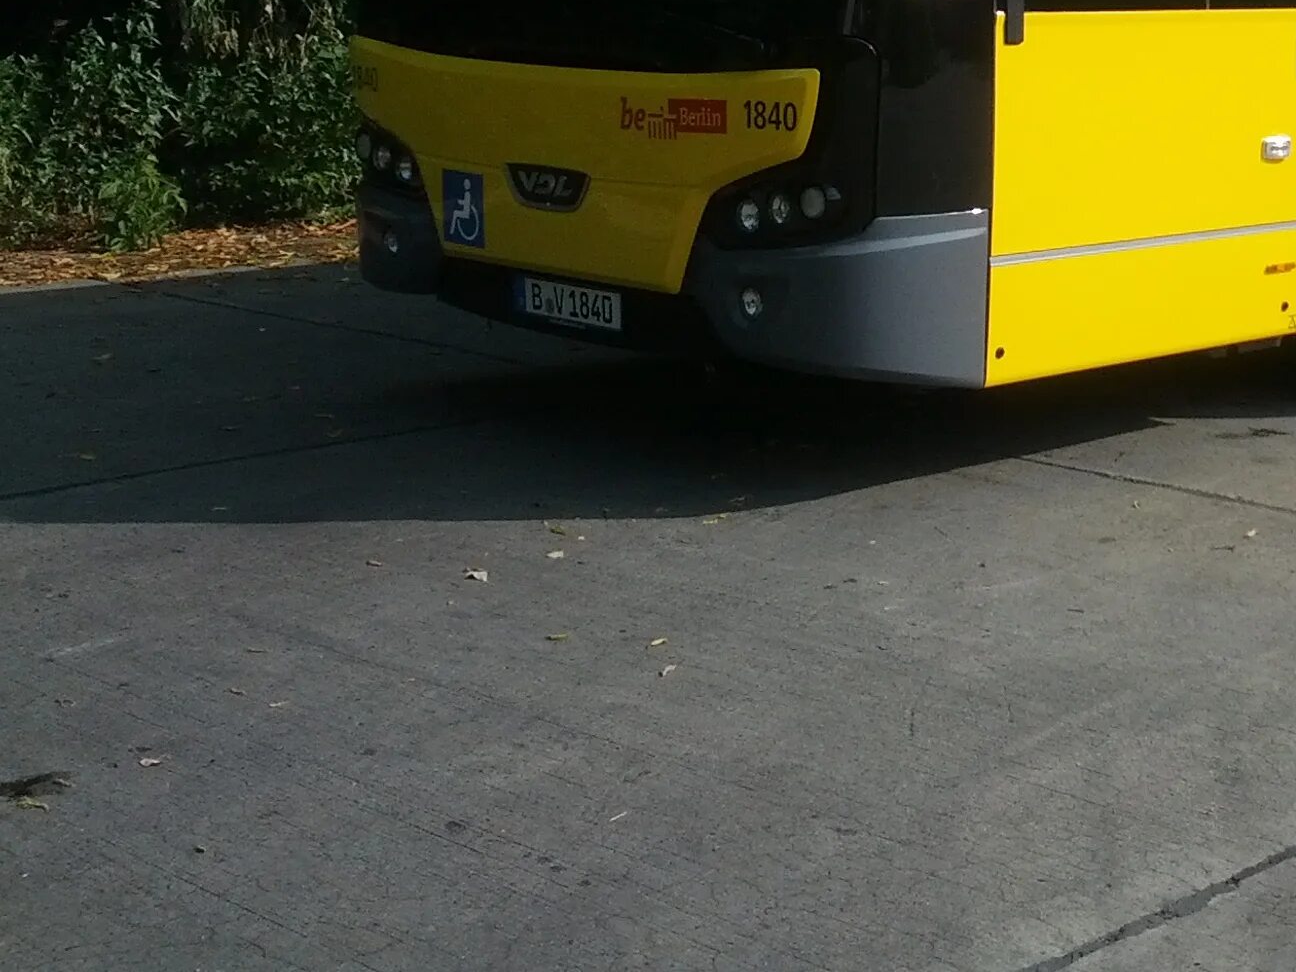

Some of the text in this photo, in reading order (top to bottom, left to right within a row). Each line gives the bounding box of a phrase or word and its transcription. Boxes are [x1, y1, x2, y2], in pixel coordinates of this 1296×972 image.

[620, 96, 721, 130] be Berlin
[743, 100, 797, 131] 1840
[517, 170, 573, 197] VDL
